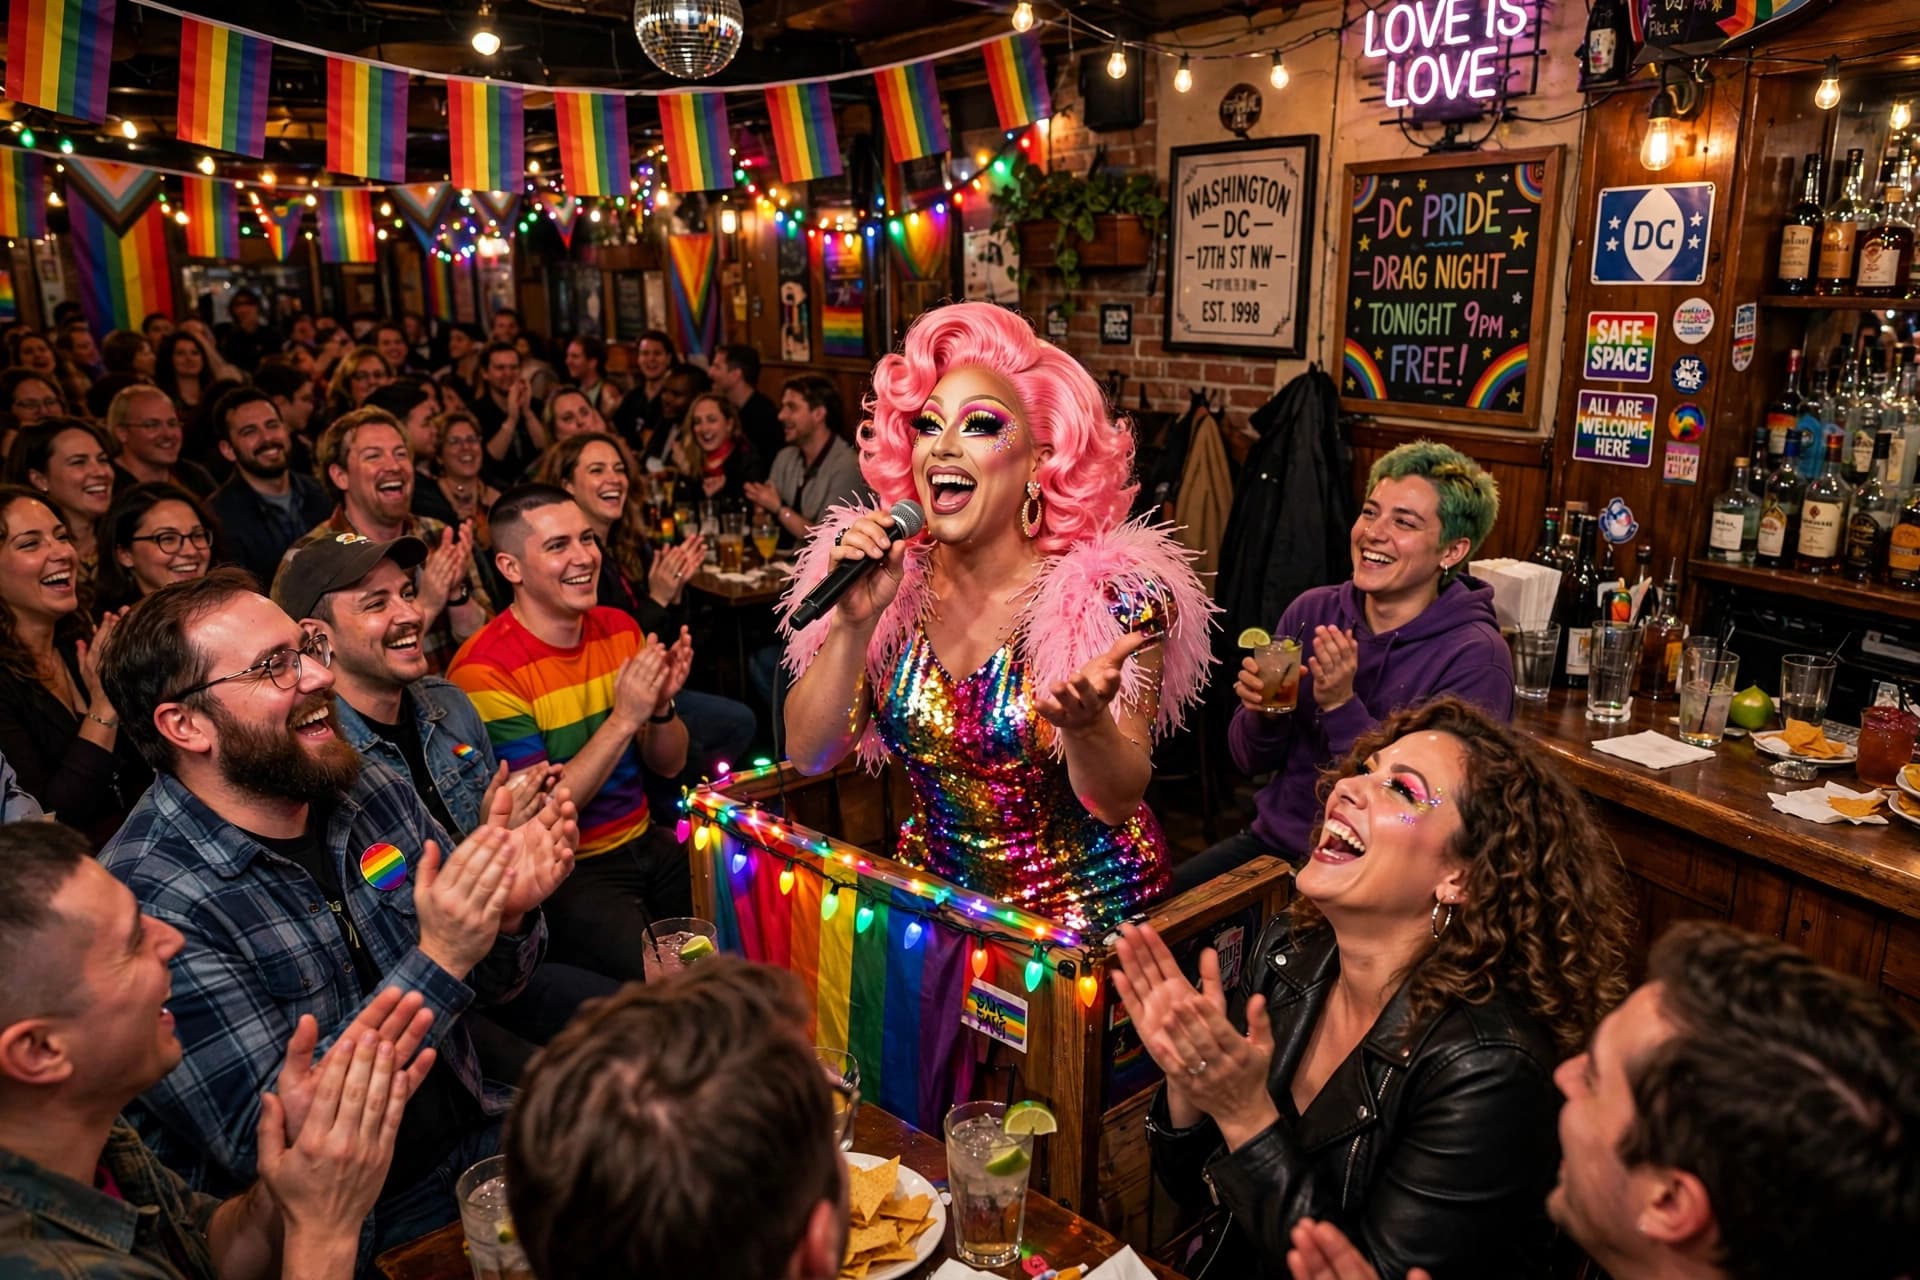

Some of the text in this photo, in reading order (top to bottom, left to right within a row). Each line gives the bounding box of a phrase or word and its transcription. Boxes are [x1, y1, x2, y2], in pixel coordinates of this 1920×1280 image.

[1364, 0, 1528, 58] LOVE IS
[1385, 46, 1498, 108] LOVE
[1186, 174, 1291, 220] WASHINGTON
[1223, 210, 1250, 239] DC
[1377, 189, 1504, 240] DC PRIDE
[1632, 219, 1676, 251] DC
[1196, 245, 1273, 270] 17TH ST NW
[1372, 253, 1506, 291] DRAG NIGHT
[1201, 300, 1260, 324] EST. 1998
[1368, 300, 1504, 339] TONIGHT 9PM
[1596, 319, 1645, 346] SAFE
[1390, 343, 1470, 388] FREE!
[1590, 345, 1649, 373] SPACE
[1587, 396, 1644, 419] ALL ARE
[1581, 416, 1649, 440] WELCOME
[1594, 438, 1631, 459] HERE
